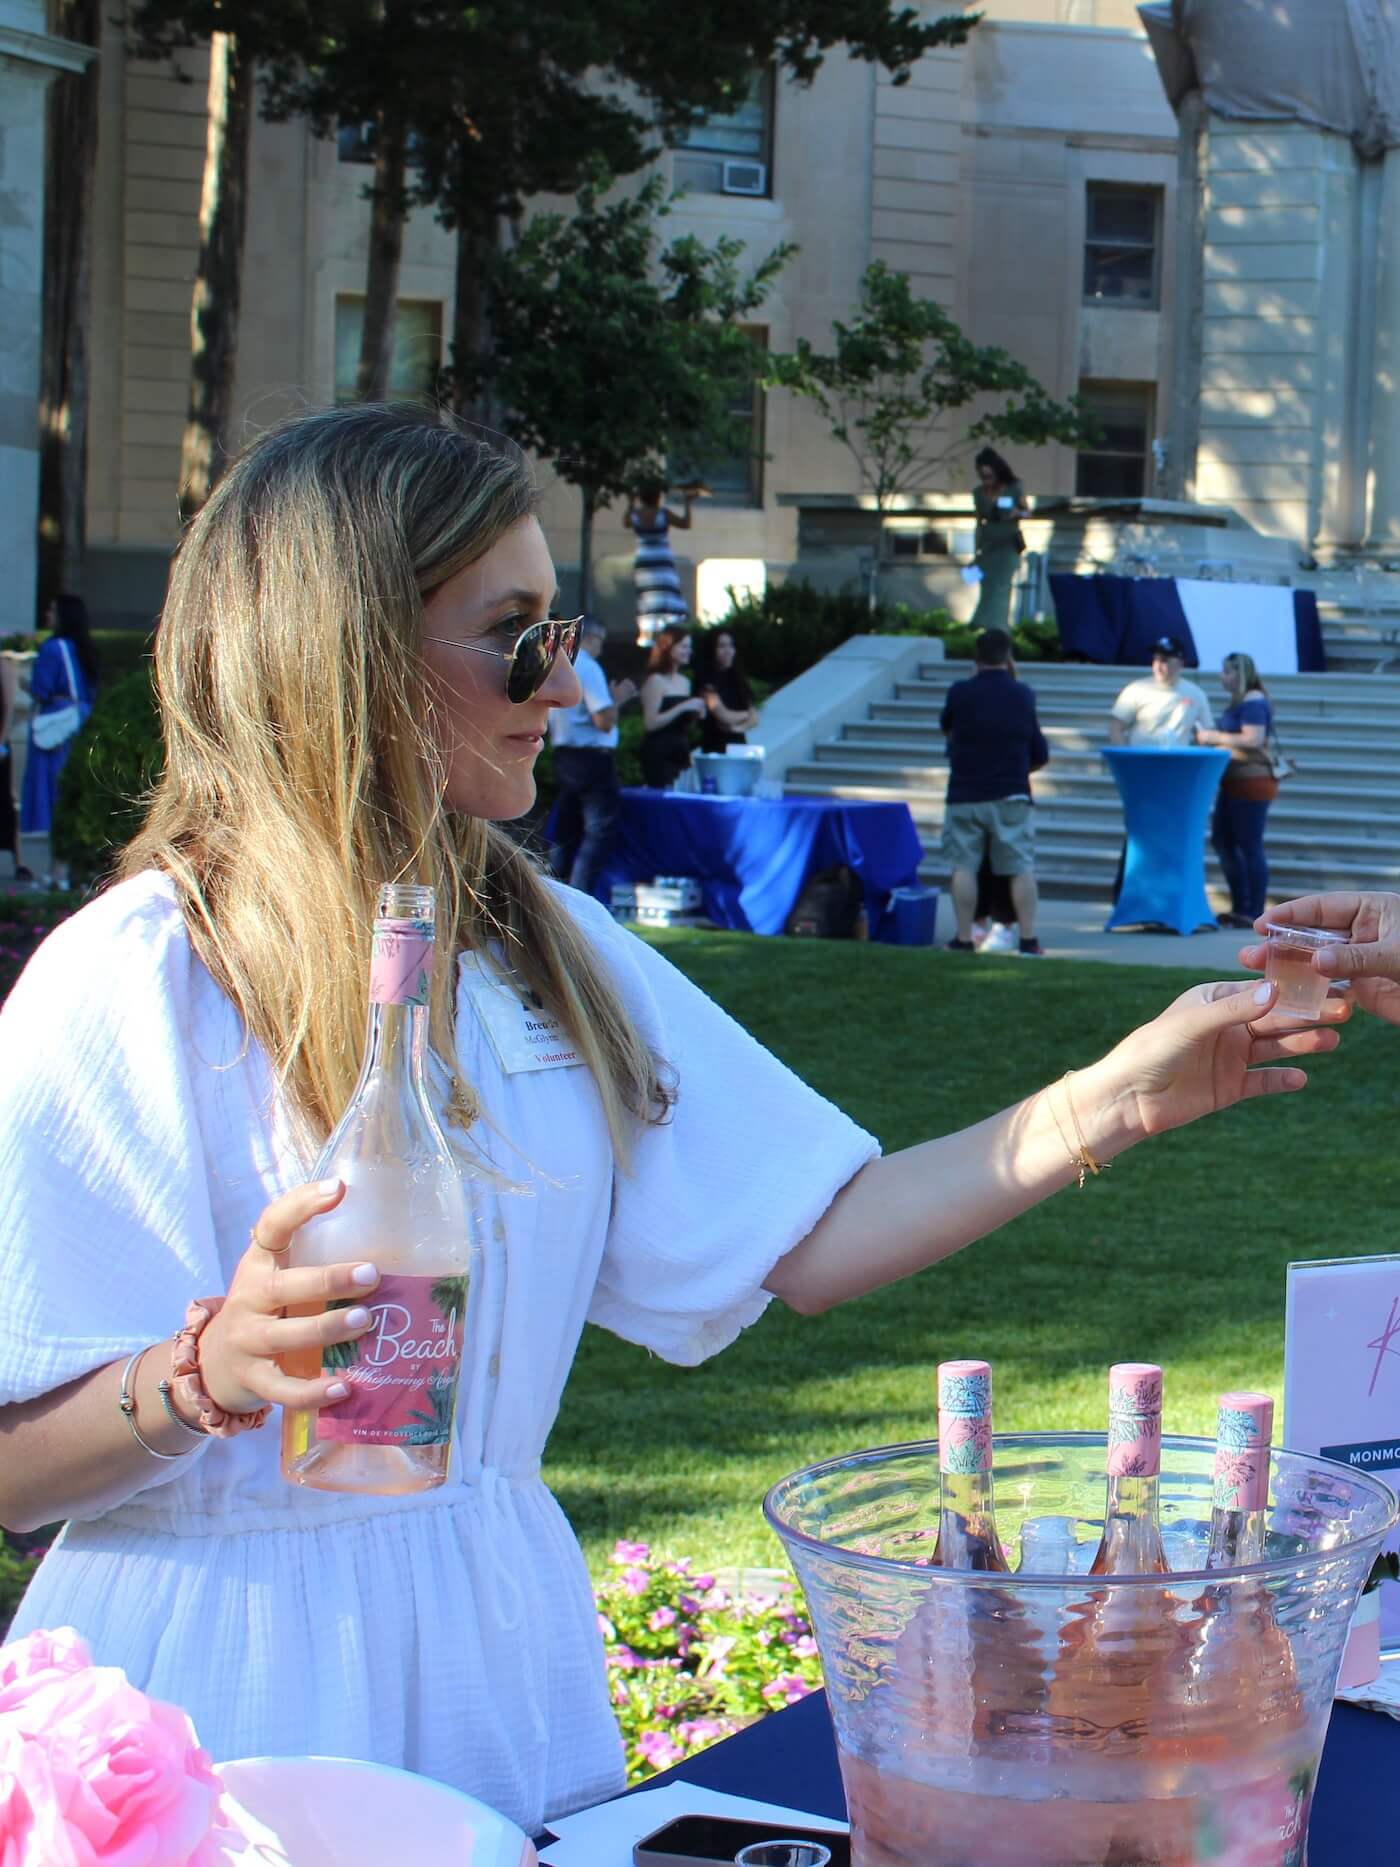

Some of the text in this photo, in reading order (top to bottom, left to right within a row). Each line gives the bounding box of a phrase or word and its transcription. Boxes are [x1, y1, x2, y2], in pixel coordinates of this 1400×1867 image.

[535, 1051, 576, 1063] Volunteer
[365, 1303, 457, 1366] Beach
[430, 1318, 446, 1333] The
[345, 1365, 425, 1391] Whispering
